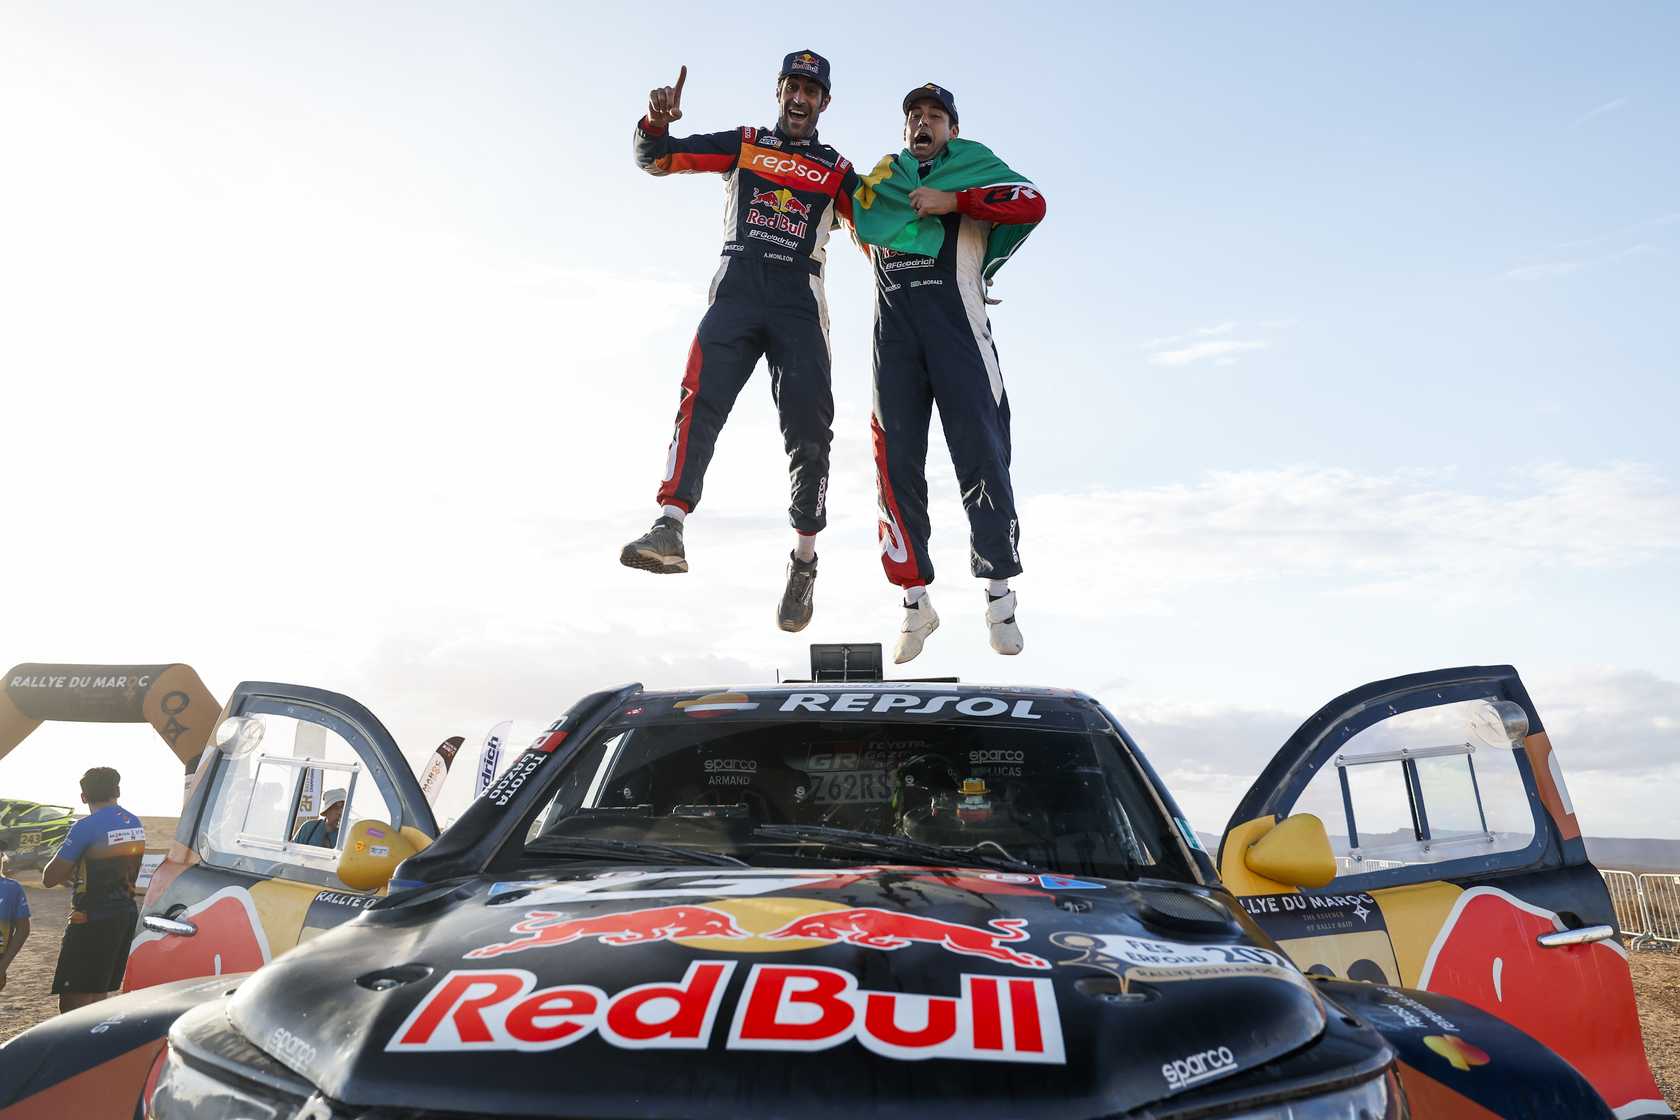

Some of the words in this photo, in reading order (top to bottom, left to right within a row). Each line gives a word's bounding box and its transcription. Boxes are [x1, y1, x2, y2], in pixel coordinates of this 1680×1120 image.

[752, 153, 830, 185] repsol
[984, 184, 1039, 204] GR
[746, 208, 780, 230] Red
[779, 211, 808, 240] Bull
[748, 229, 799, 250] BFGoodrich
[885, 257, 935, 271] BFGoodrich
[10, 676, 66, 688] RALLYE
[68, 676, 91, 688] DU
[778, 692, 1042, 720] REPSOL
[703, 758, 758, 773] sparco
[968, 750, 1025, 764] sparco
[496, 753, 548, 807] TOYOTA
[708, 775, 750, 786] ARMAND
[22, 833, 41, 844] 243
[316, 892, 361, 907] RALLYE
[1282, 895, 1307, 911] DU
[1309, 894, 1375, 909] MAROC
[1126, 939, 1172, 955] FES
[387, 961, 737, 1052] Red
[728, 963, 1066, 1064] Bull
[1162, 1046, 1237, 1089] sparco
